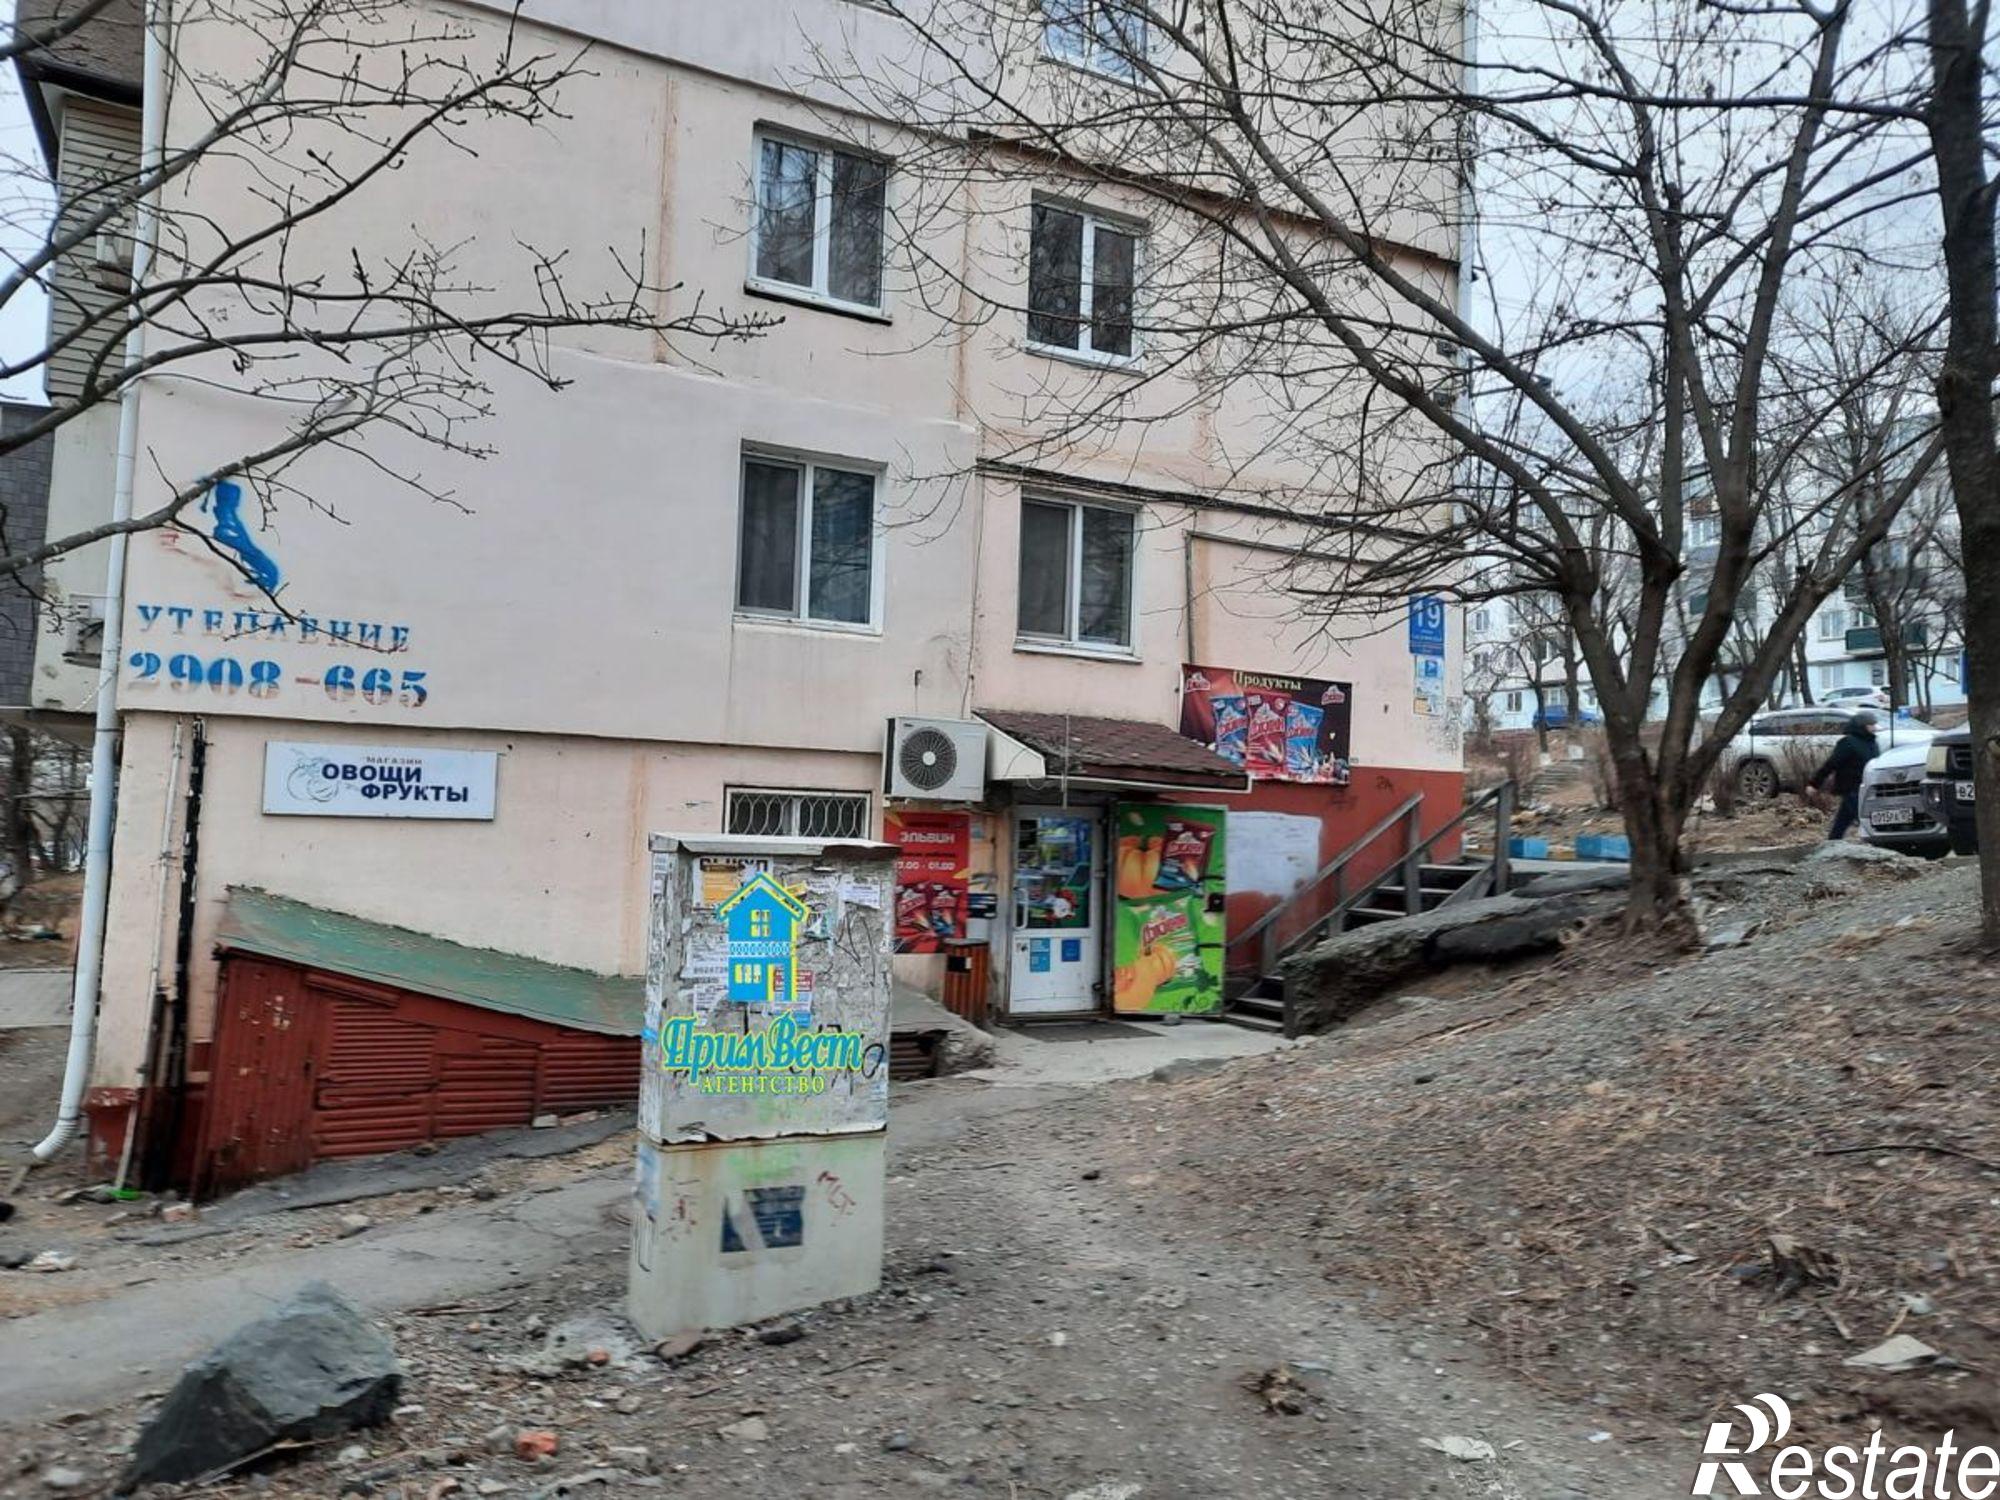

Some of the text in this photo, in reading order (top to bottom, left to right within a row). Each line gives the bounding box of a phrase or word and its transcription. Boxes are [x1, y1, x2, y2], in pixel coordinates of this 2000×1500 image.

[1413, 600, 1441, 629] 19
[136, 605, 410, 652] УТЕПЛЕНИЕ
[127, 652, 428, 708] 2908-665
[1233, 671, 1302, 691] Продукты
[321, 763, 423, 784] ОВОЩИ
[360, 783, 468, 803] ФРУКТЫ
